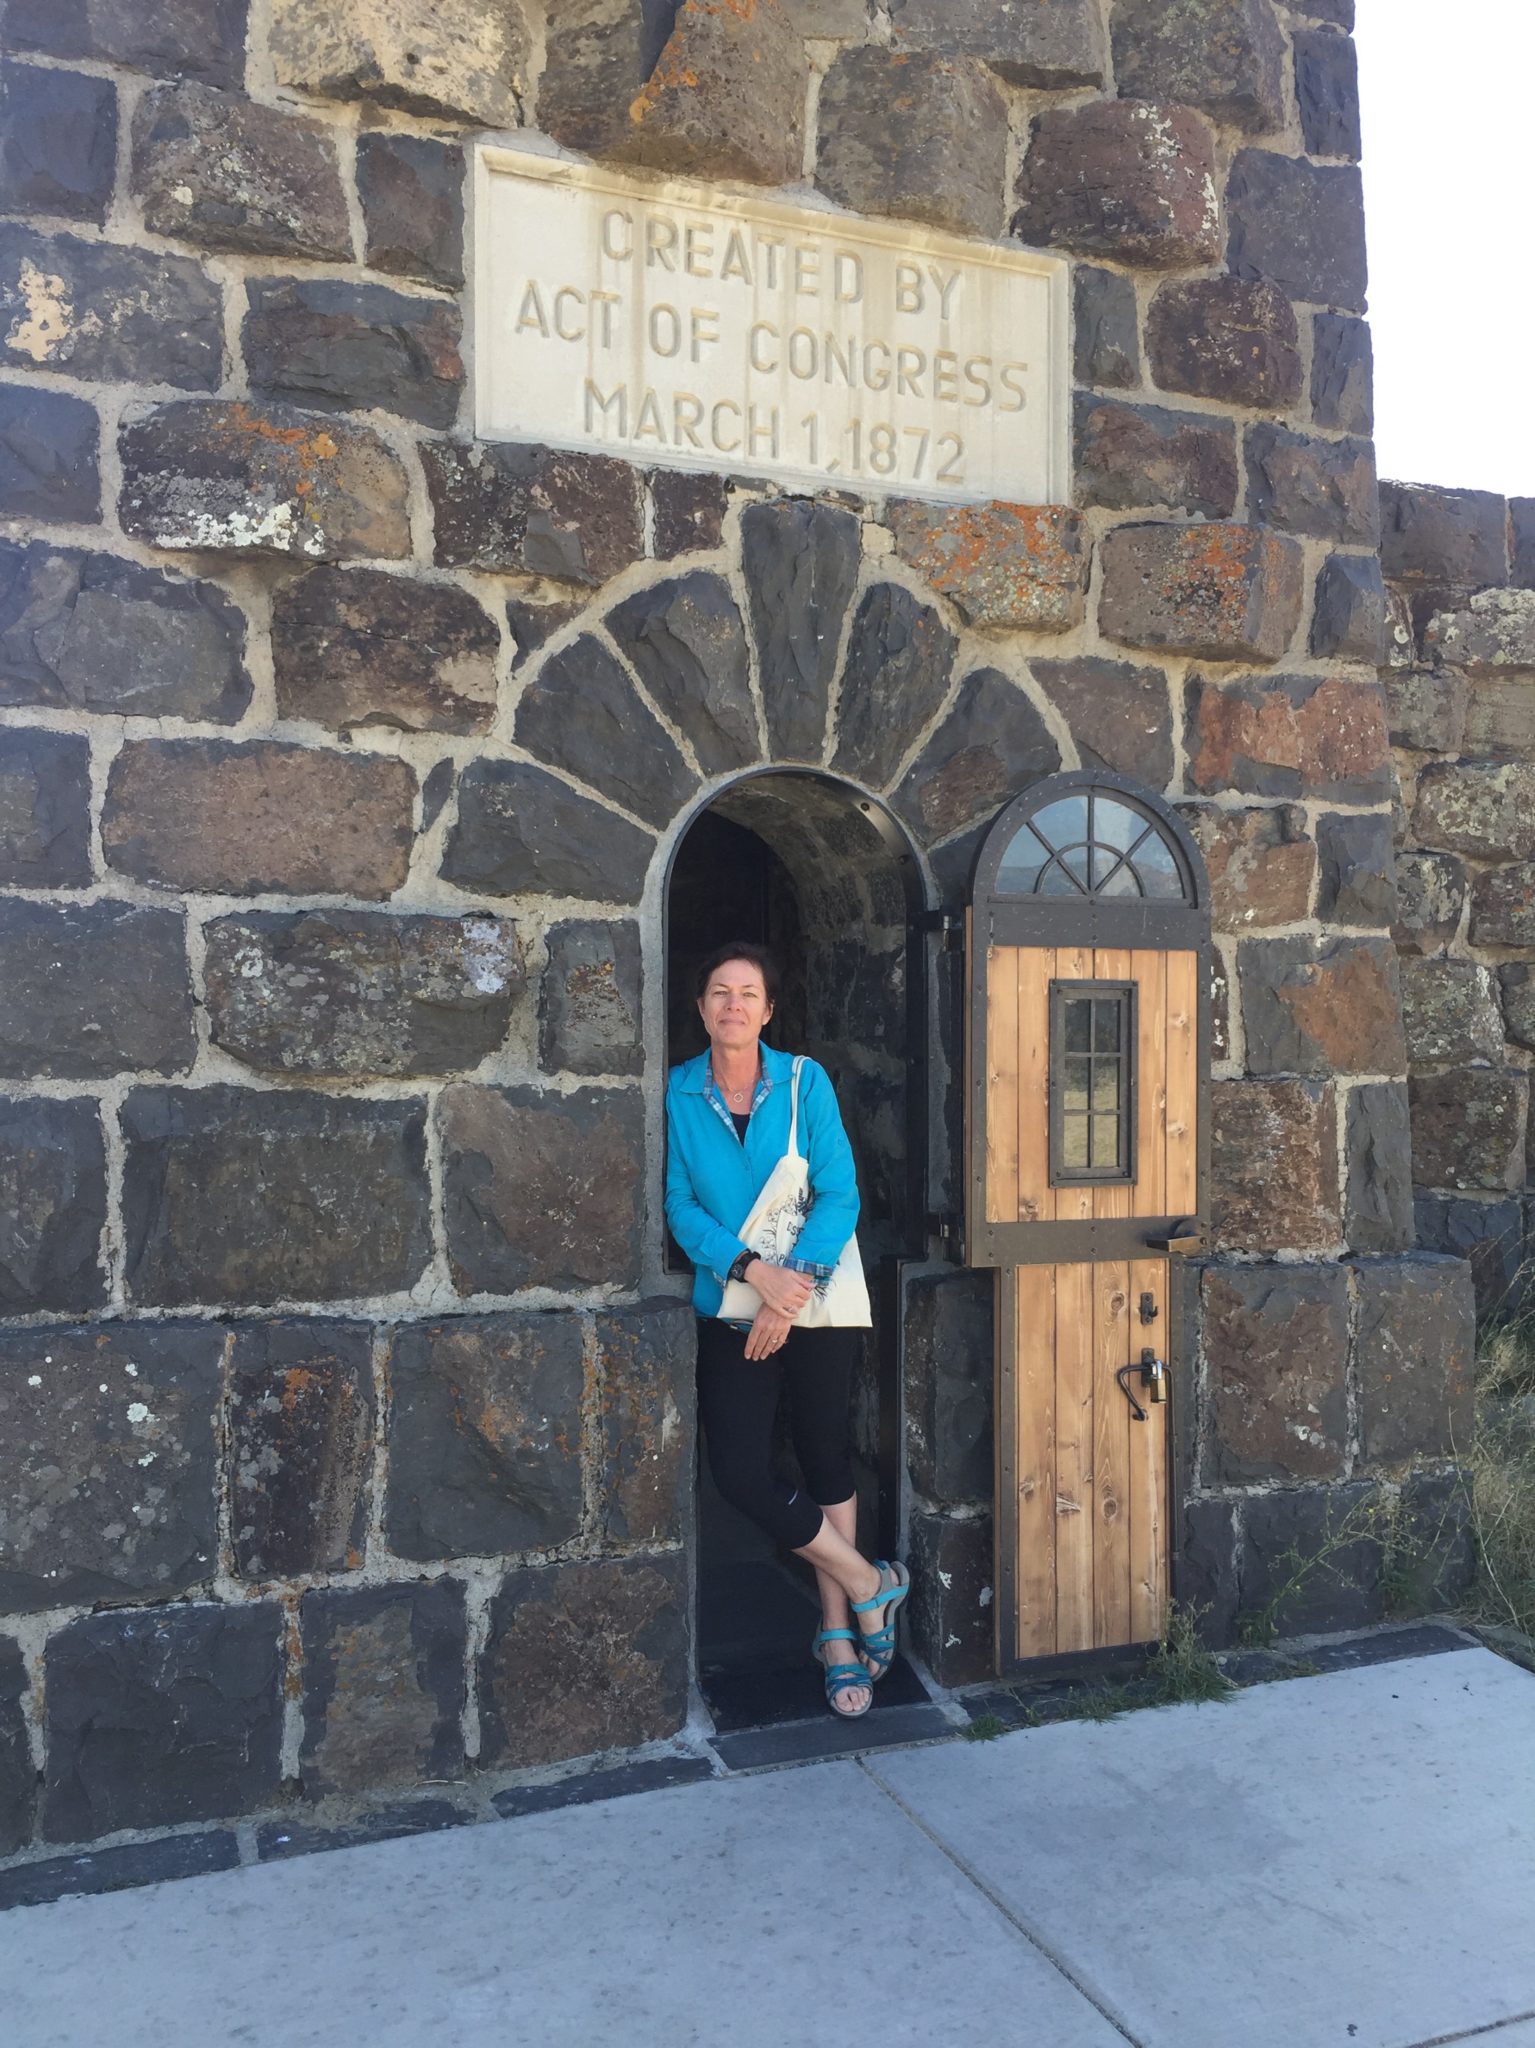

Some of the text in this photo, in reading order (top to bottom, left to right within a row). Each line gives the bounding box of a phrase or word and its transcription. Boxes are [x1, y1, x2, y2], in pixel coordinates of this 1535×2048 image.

[603, 210, 961, 320] CREATED BY
[515, 280, 1028, 413] ACT OF CONGRESS
[584, 379, 780, 460] MARCH
